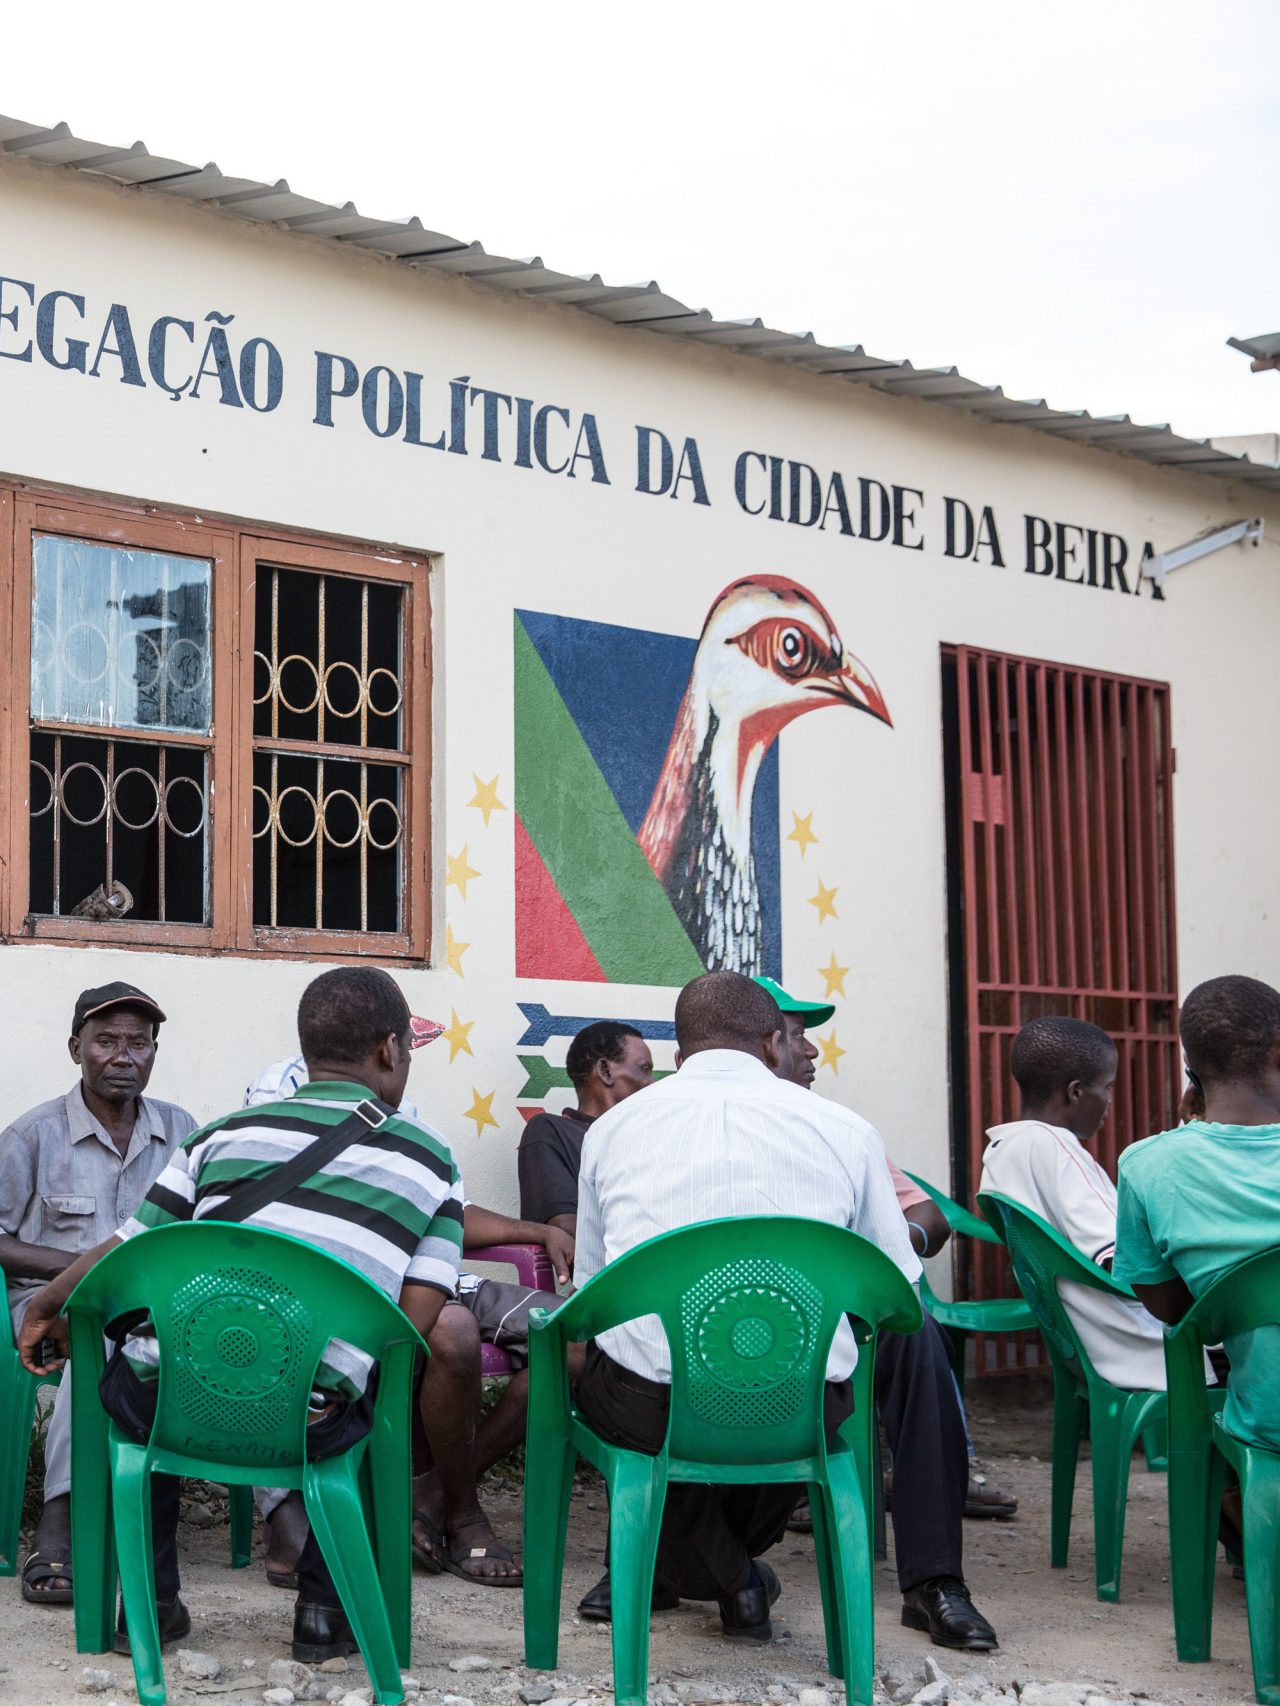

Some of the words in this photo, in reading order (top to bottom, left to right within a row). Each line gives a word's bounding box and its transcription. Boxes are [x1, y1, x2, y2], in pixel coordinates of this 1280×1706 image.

[312, 350, 611, 486] POLÍTICA
[634, 425, 712, 507] DA
[734, 451, 924, 551] CIDADE
[942, 496, 1006, 569] DA
[1023, 514, 1166, 602] BEIRA
